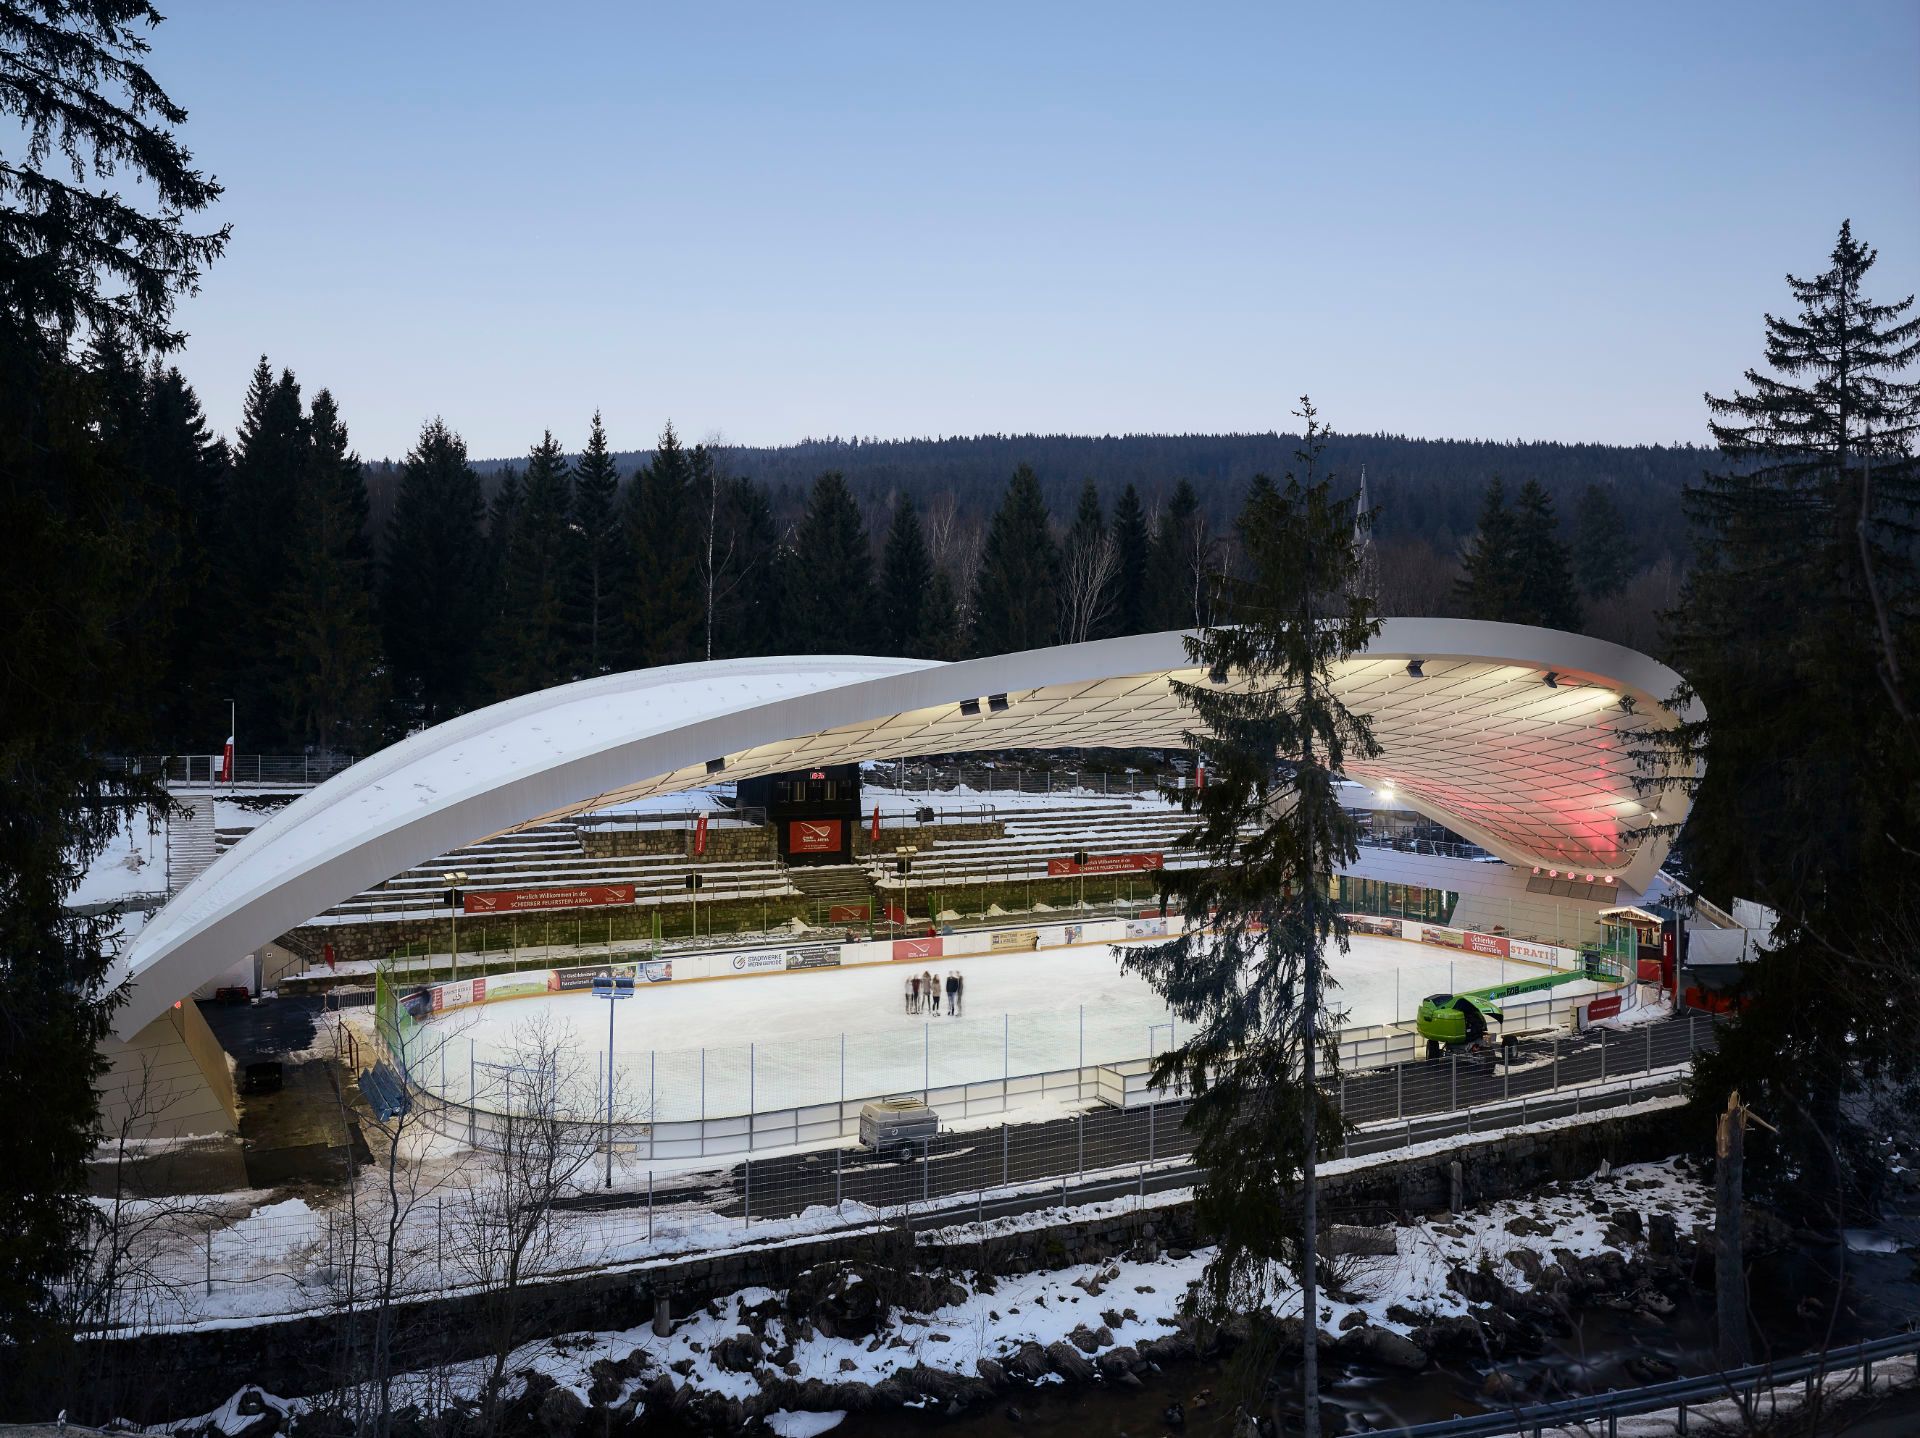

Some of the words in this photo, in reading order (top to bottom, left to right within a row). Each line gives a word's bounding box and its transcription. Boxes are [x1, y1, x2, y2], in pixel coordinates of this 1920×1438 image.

[539, 891, 572, 899] Willkommen
[1471, 934, 1497, 946] Schierker
[1472, 943, 1502, 955] Feuerstein
[1511, 945, 1556, 961] STRATIE
[747, 953, 782, 962] STADTWERKE
